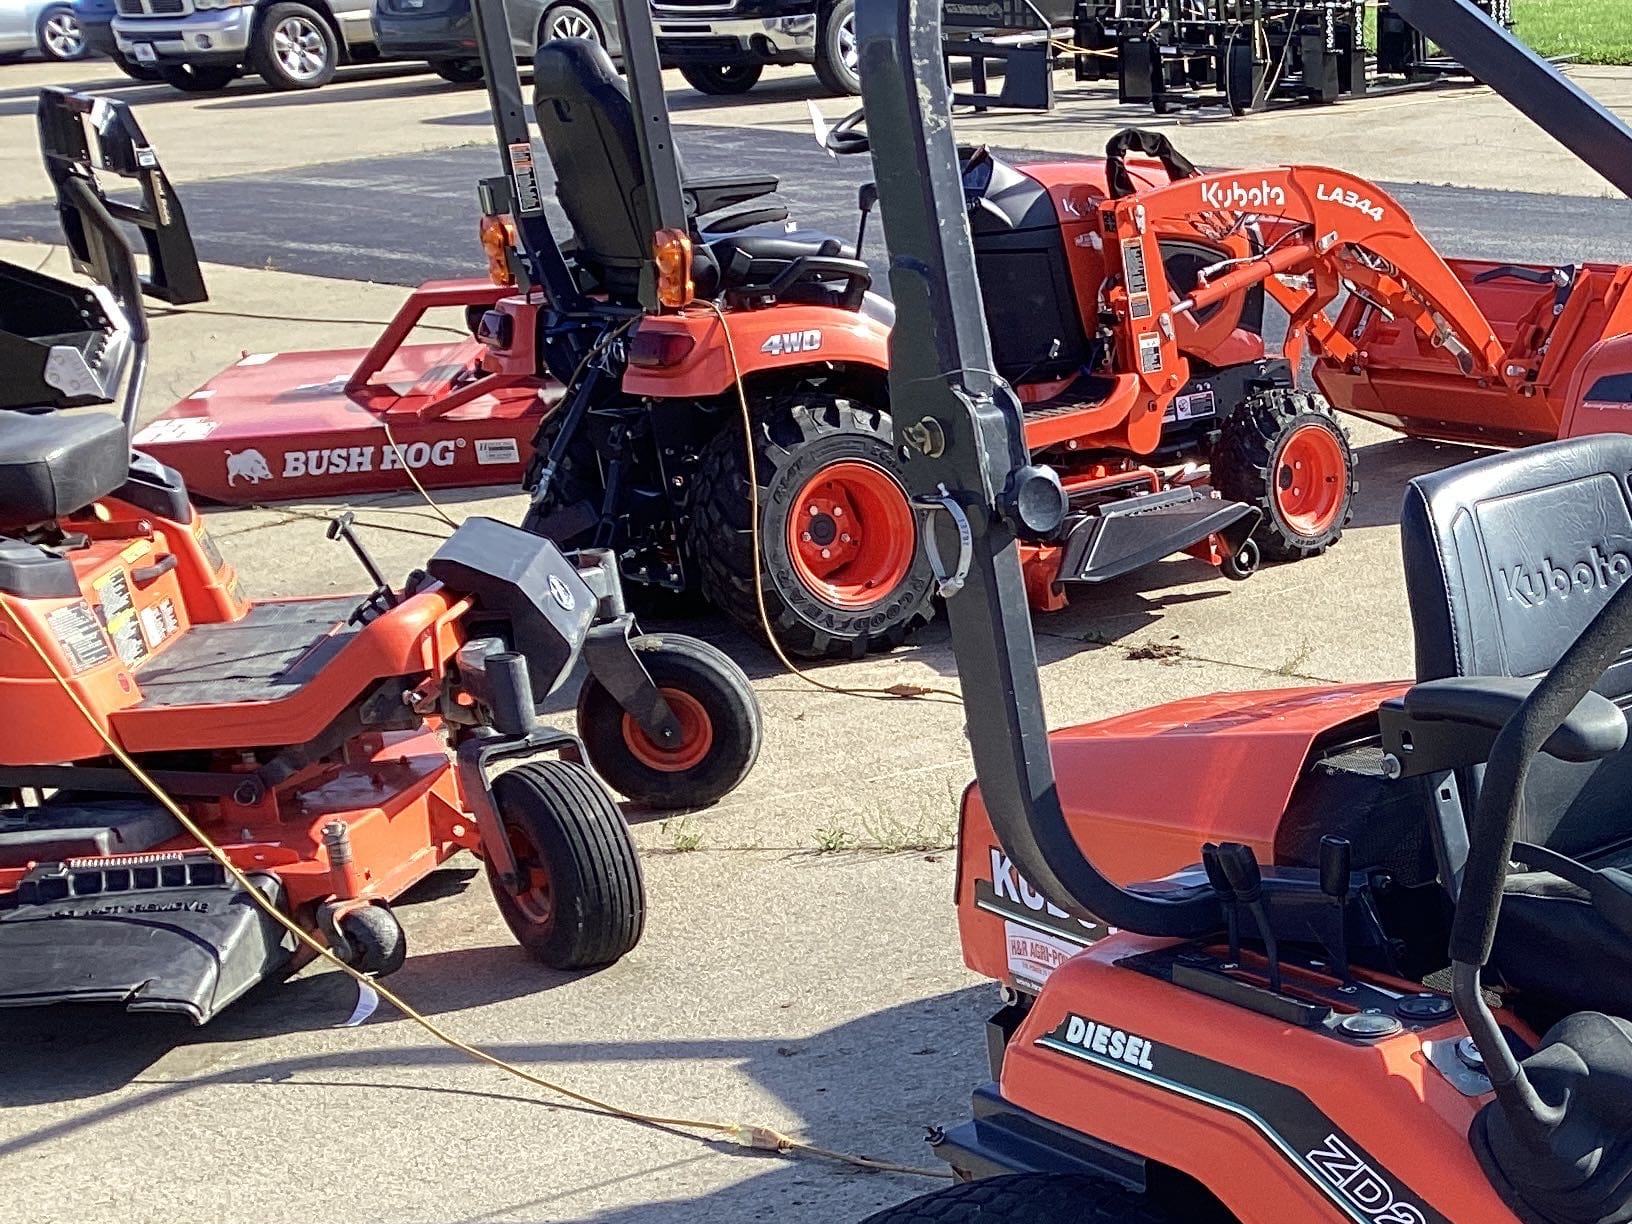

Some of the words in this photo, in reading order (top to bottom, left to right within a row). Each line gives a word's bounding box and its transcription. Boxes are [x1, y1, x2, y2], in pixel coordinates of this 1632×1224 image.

[1201, 180, 1285, 209] Kubota
[1317, 184, 1385, 222] LA344
[760, 329, 822, 356] 4WD
[283, 446, 374, 478] BUSH
[380, 440, 455, 470] HOG
[1065, 1014, 1153, 1071] DIESEL
